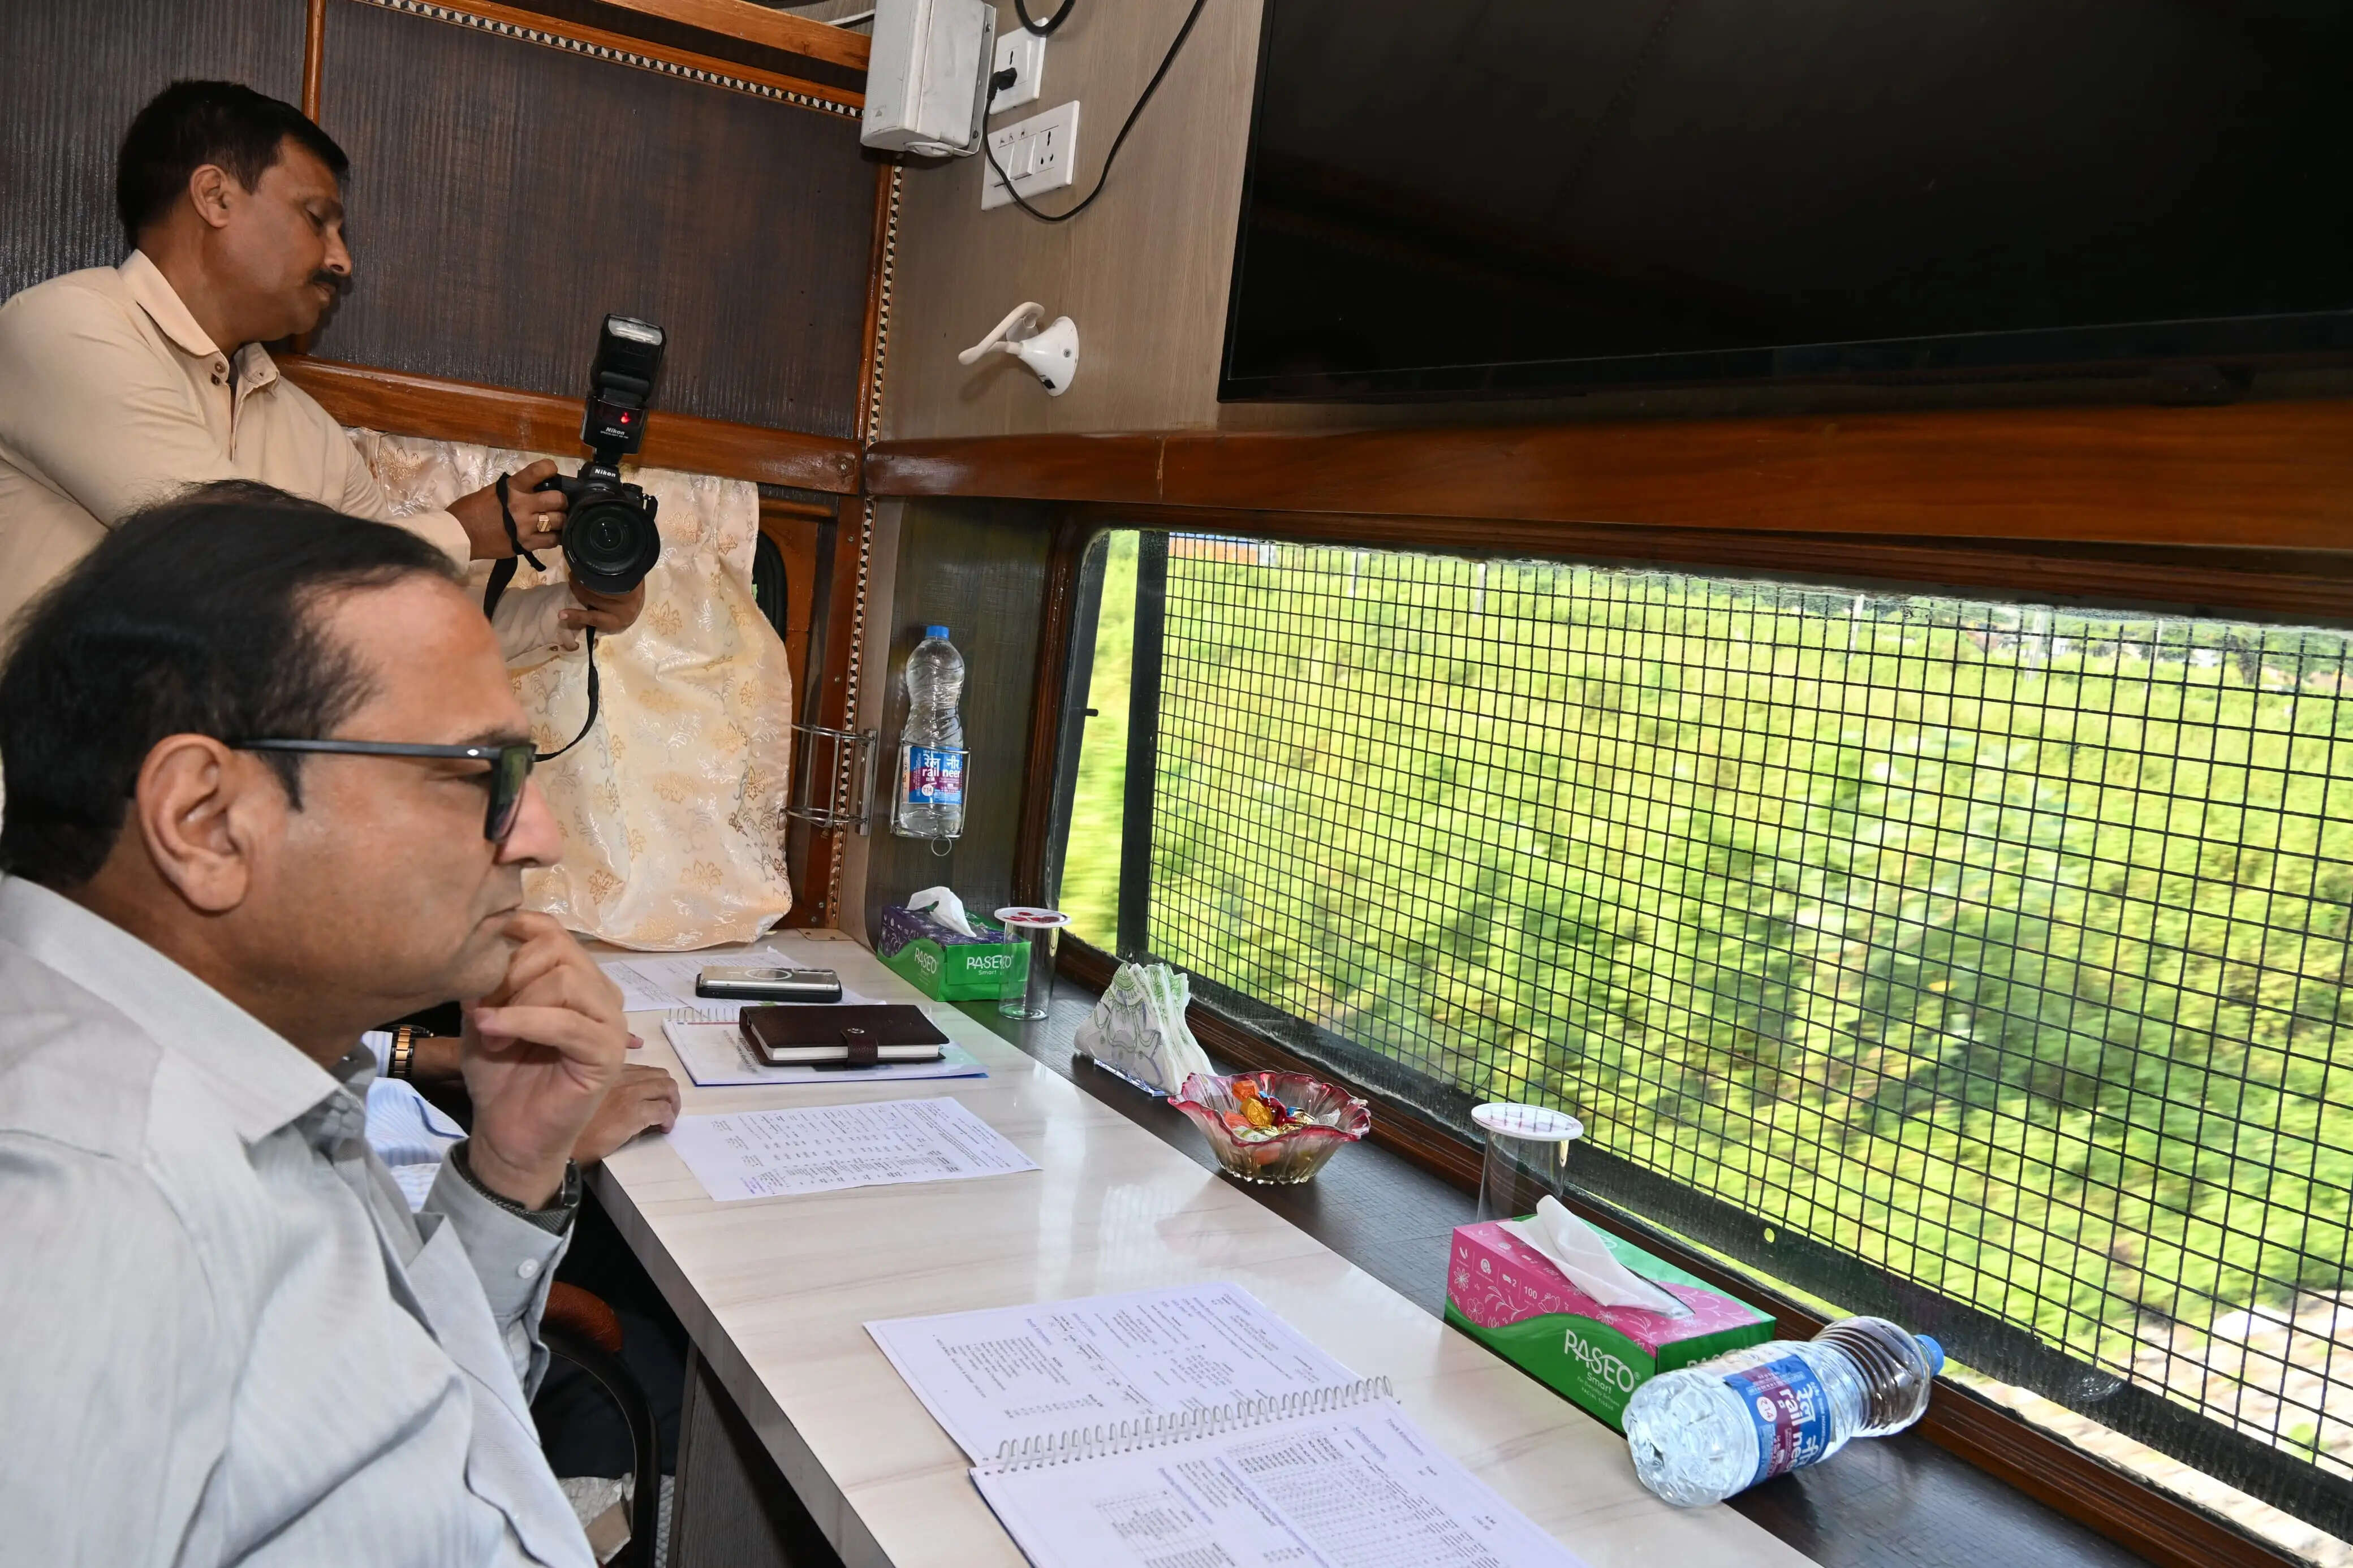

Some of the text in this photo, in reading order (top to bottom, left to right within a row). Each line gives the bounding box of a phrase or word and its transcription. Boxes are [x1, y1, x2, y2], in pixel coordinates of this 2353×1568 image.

[594, 468, 616, 477] Nikon
[923, 754, 960, 770] रेल नीर
[922, 767, 940, 777] rail
[914, 947, 937, 974] PASEO
[967, 955, 1012, 970] PASEO
[1524, 1286, 1537, 1299] 100
[1565, 1328, 1634, 1393] PASEO
[1587, 1371, 1612, 1394] Smart
[1581, 1387, 1597, 1402] FACIAL
[1796, 1383, 1816, 1423] रेल
[1778, 1389, 1803, 1471] rail nee
